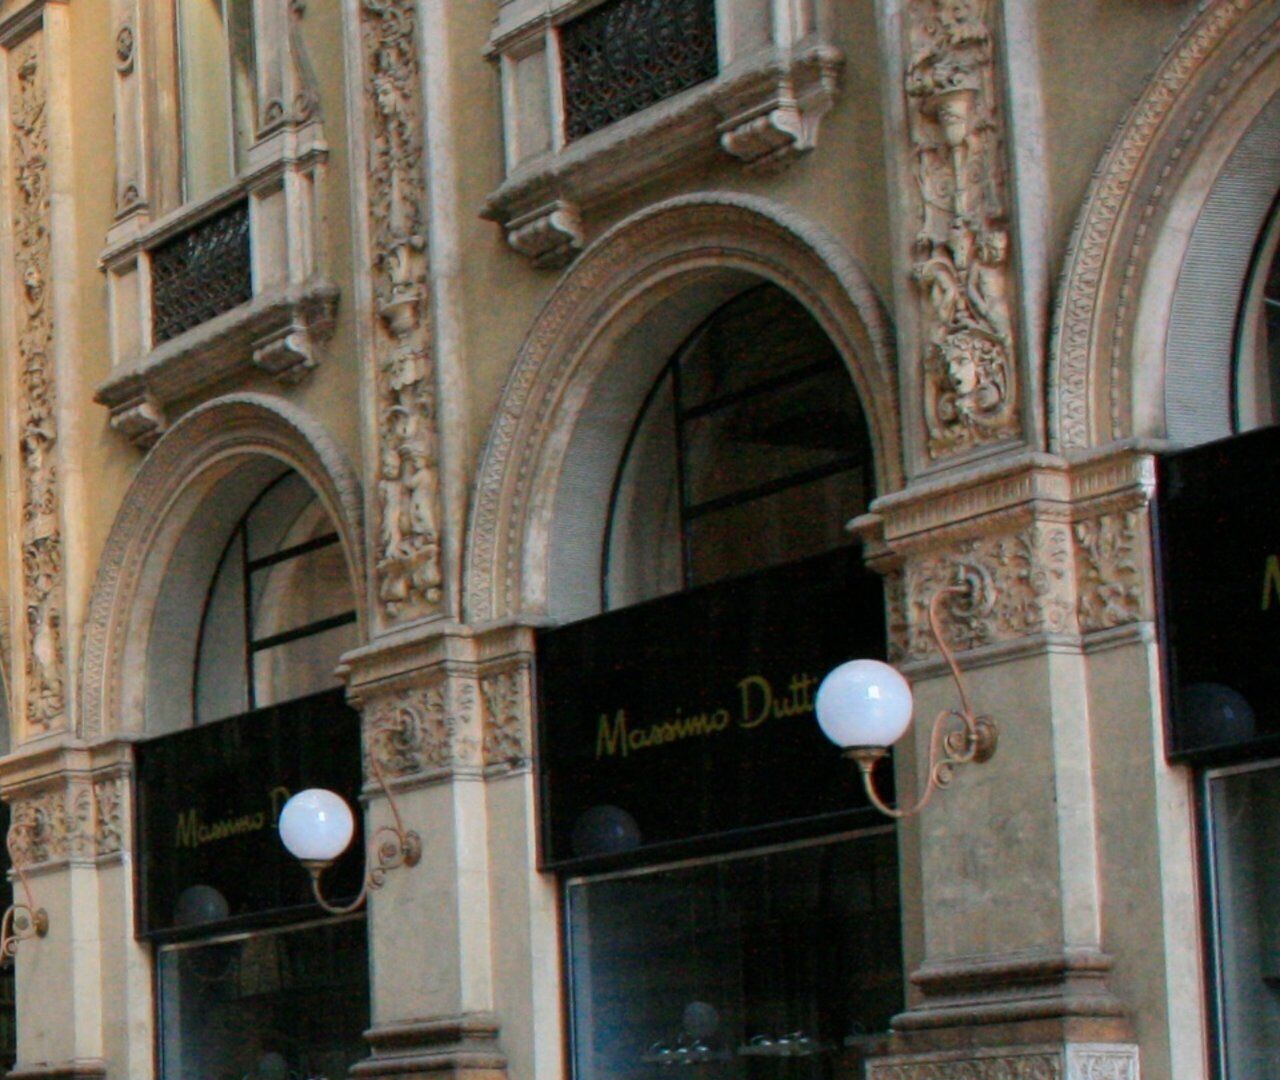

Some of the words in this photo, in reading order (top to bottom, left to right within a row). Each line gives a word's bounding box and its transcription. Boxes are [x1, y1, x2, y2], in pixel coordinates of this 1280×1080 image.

[595, 706, 731, 759] Massimo
[738, 672, 817, 729] Dutt
[175, 807, 265, 848] Massimo
